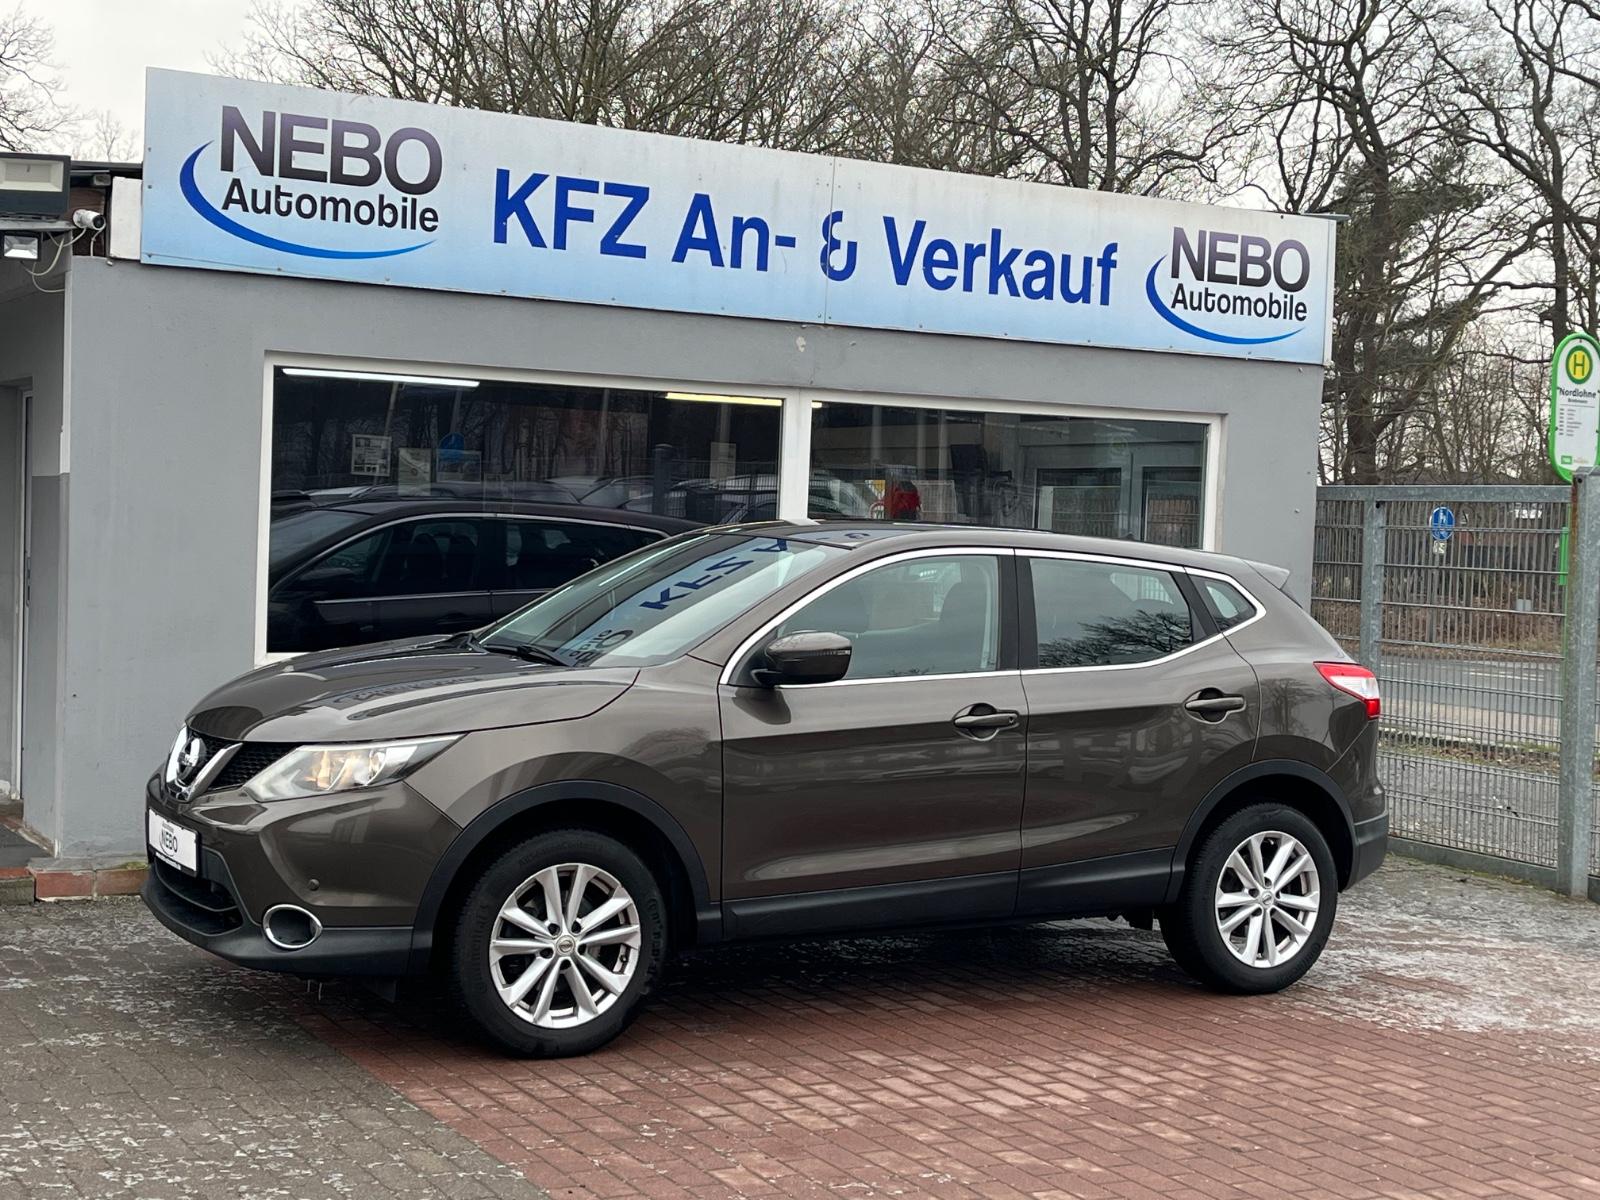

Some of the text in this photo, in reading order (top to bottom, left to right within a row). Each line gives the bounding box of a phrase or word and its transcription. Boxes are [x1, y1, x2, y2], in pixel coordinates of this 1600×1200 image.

[220, 105, 443, 195] NEBO
[221, 178, 439, 232] Automobile
[494, 168, 1118, 306] KFZ An- & Verkauf
[1170, 226, 1310, 293] NEBO
[1170, 283, 1308, 322] Automobile
[1573, 354, 1585, 376] H
[1559, 387, 1597, 398] Nordlohne
